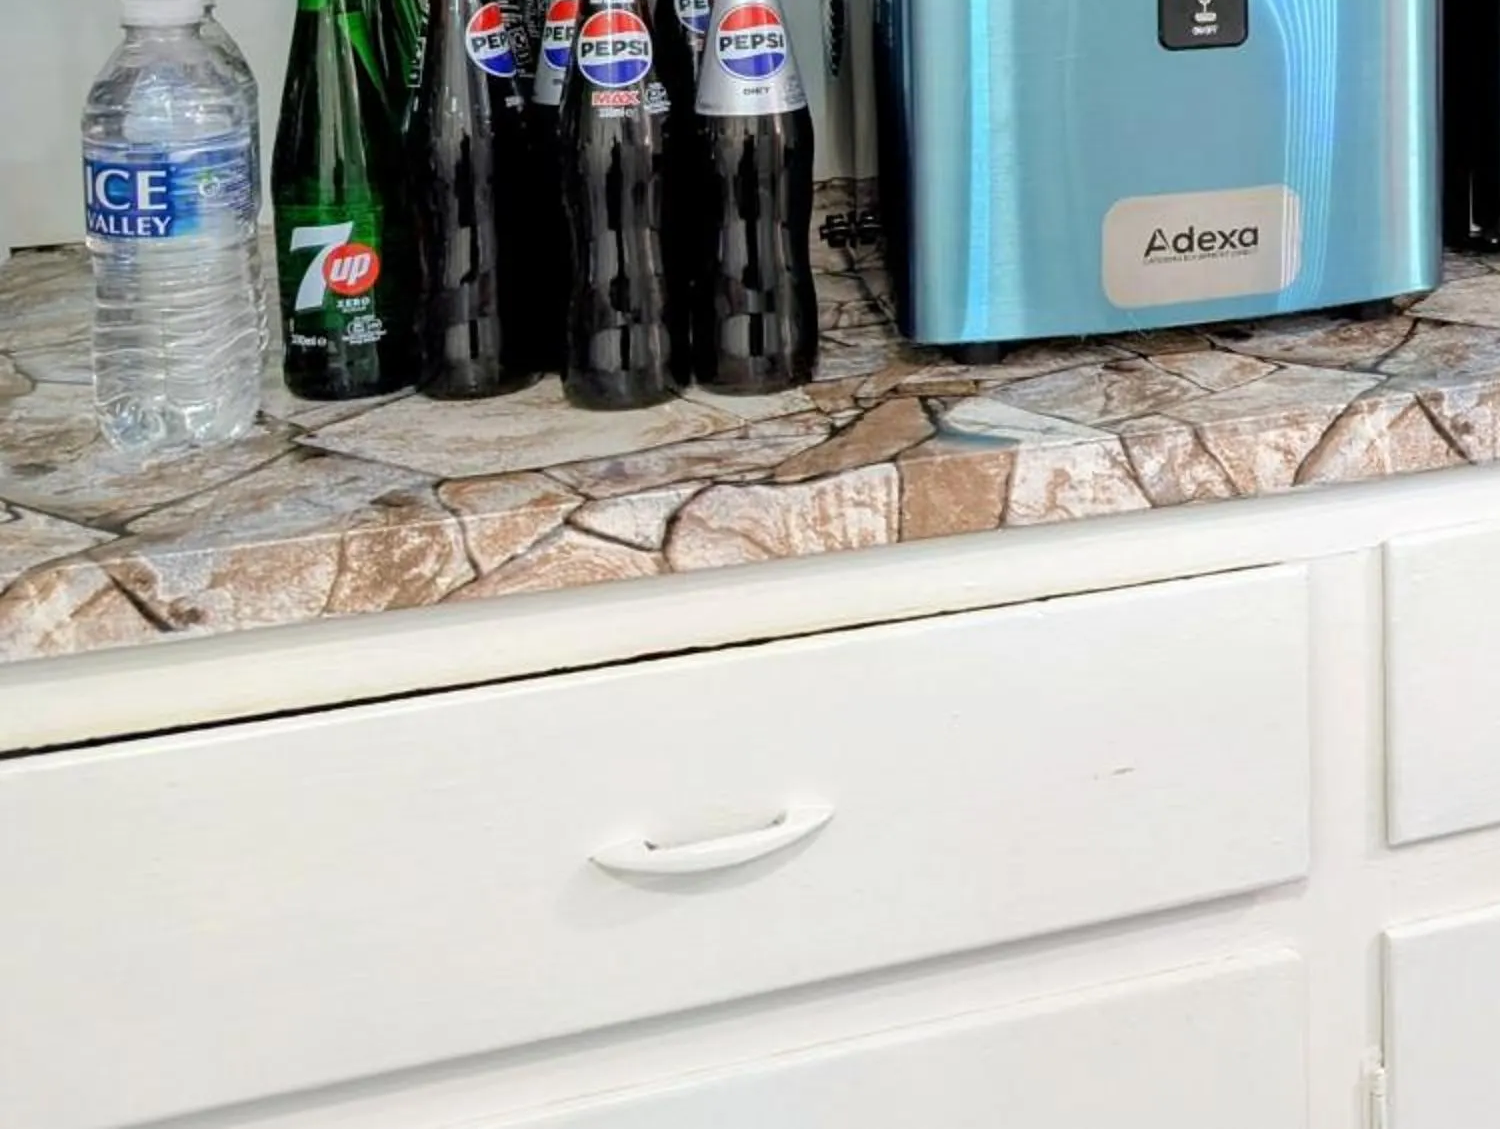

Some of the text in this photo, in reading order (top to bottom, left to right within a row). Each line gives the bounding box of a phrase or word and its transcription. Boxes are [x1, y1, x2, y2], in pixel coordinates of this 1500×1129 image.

[580, 39, 648, 58] PEPSI
[719, 32, 784, 52] PEPSI
[591, 90, 641, 106] MAX
[86, 165, 168, 211] ICE
[87, 215, 171, 236] VALLEY
[1144, 225, 1260, 258] Adexa
